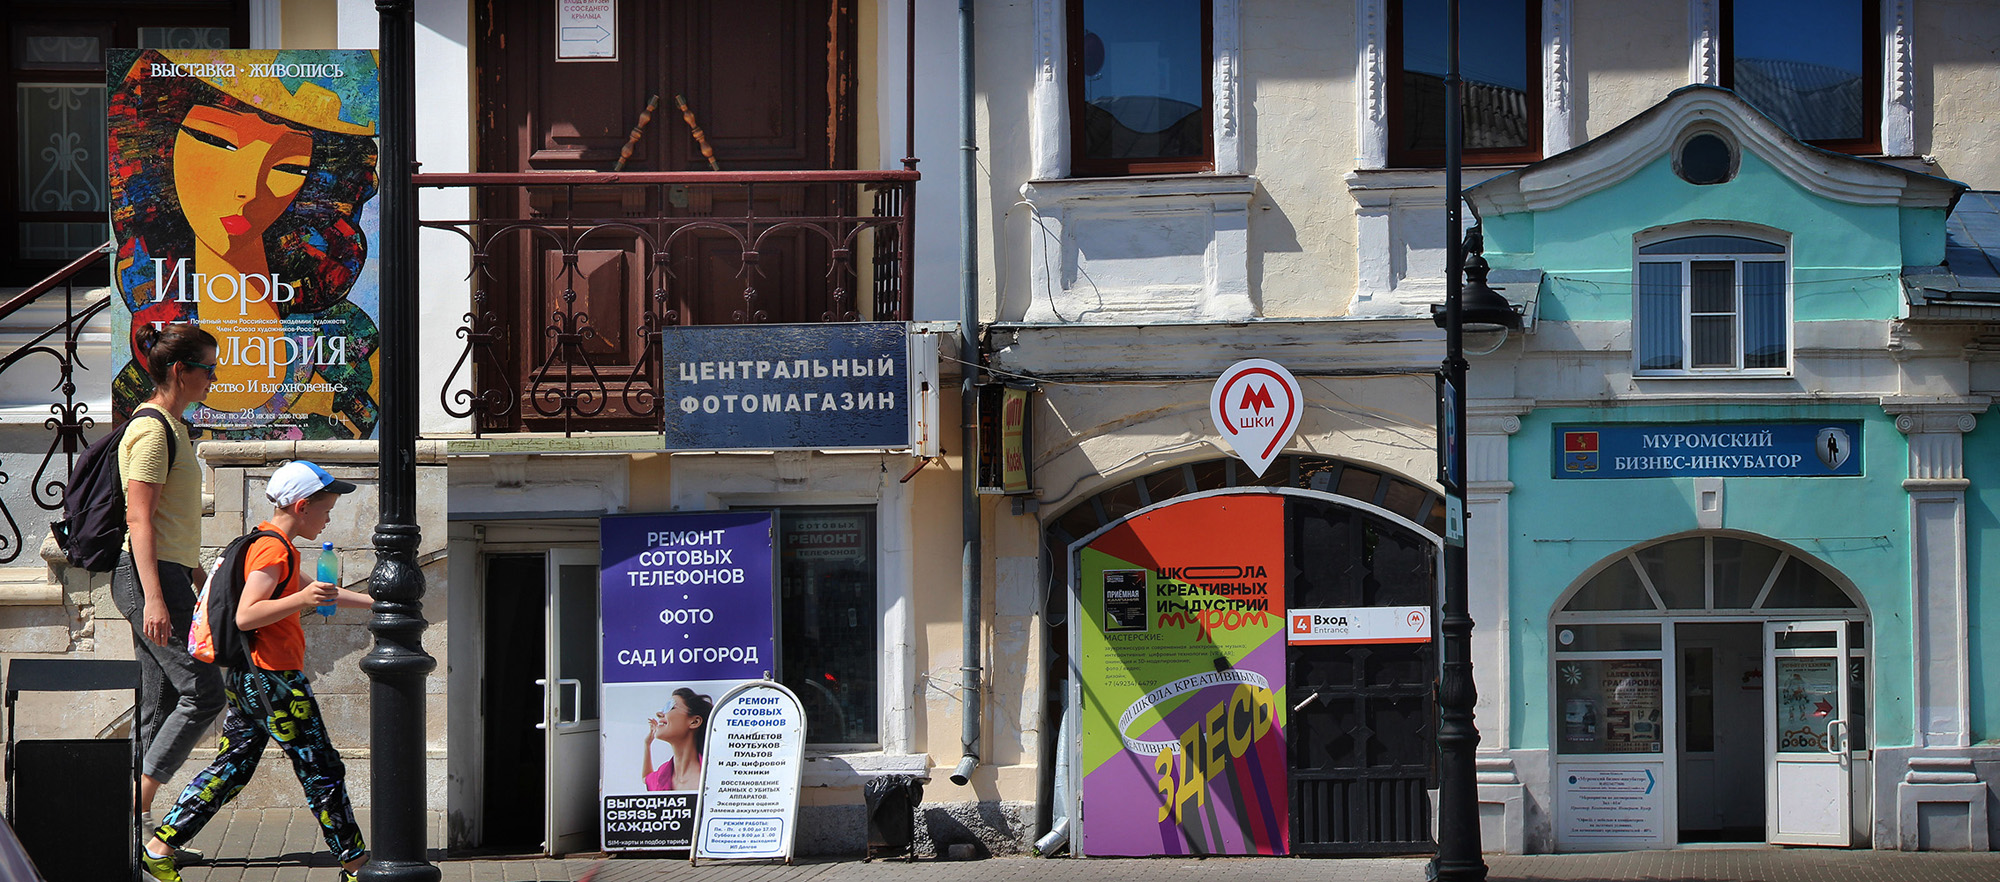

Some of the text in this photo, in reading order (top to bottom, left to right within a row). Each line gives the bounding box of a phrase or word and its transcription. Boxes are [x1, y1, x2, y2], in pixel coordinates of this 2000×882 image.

[150, 258, 294, 315] Игорь
[190, 318, 221, 326] Почётный
[680, 354, 894, 384] ЦЕНТРАЛЬНЫЙ
[247, 380, 259, 392] И
[262, 382, 348, 394] вдохновенье»
[680, 392, 894, 414] ФОТОМАГАЗИН
[199, 409, 211, 419] 15
[240, 408, 254, 419] 28
[292, 413, 309, 421] года
[329, 413, 349, 426] 0+
[1240, 417, 1274, 429] ШКИ
[1643, 430, 1773, 449] МУРОМСКИЙ
[1615, 454, 1802, 470] БИЗНЕС-ИНКУБАТОР
[798, 522, 855, 530] СОТОВЫХ
[648, 530, 725, 547] РЕМОНТ
[789, 534, 857, 544] РЕМОНТ
[639, 549, 732, 567] СОТОВЫХ
[627, 568, 745, 586] ТЕЛЕФОНОВ
[1107, 590, 1139, 598] ПРИЁМНАЯ
[1157, 582, 1267, 596] КРЕАТИВНЫХ
[1157, 596, 1268, 614] ИНДУСТРИЙ
[659, 608, 714, 624] ФОТО
[1297, 619, 1307, 630] 4
[1314, 615, 1348, 626] Вход
[618, 646, 758, 666] САД И ОГОРОД
[1132, 688, 1172, 716] ШКОЛА
[1174, 673, 1256, 693] КРЕАТИВНЫХ
[733, 708, 782, 716] СОТОВЫХ
[1155, 683, 1273, 826] ЗДЕСЬ
[742, 760, 786, 768] цифровой
[607, 798, 686, 809] ВЫГОДНАЯ
[607, 809, 691, 820] СВЯЗЬ ДЛЯ
[607, 821, 680, 832] КАЖДОГО
[666, 838, 689, 846] тарифа
